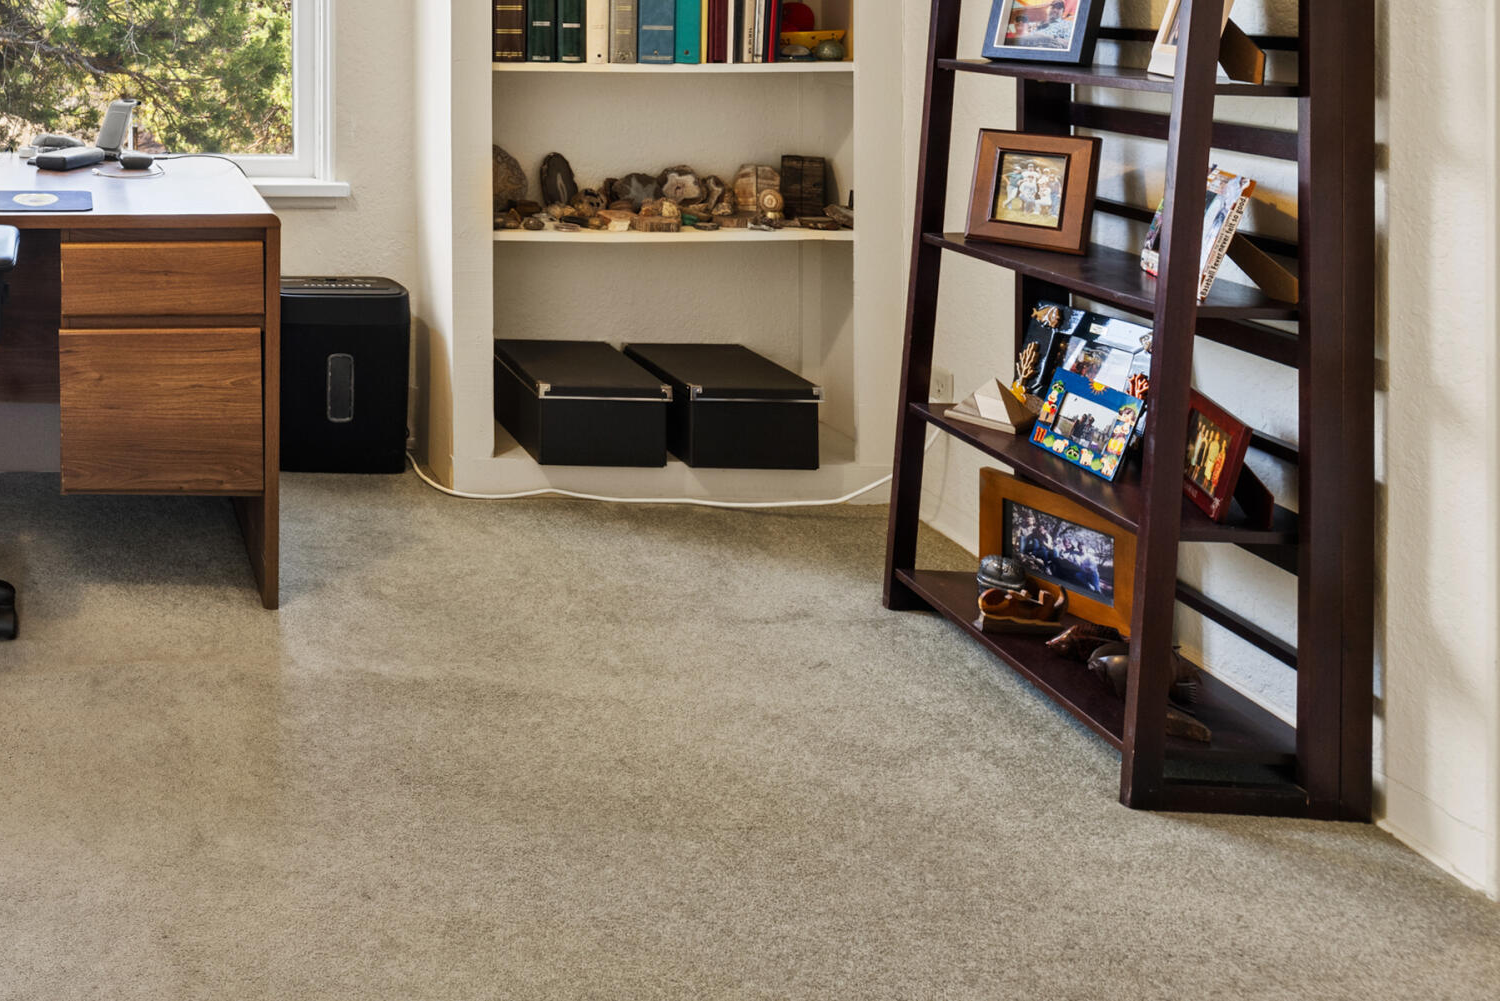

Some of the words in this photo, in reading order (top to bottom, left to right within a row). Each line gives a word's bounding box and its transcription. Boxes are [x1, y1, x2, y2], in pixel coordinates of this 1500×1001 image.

[1200, 271, 1215, 296] Baseball
[1211, 253, 1221, 271] Fever
[1218, 237, 1229, 254] never
[1226, 223, 1236, 238] felt
[1236, 198, 1246, 214] good
